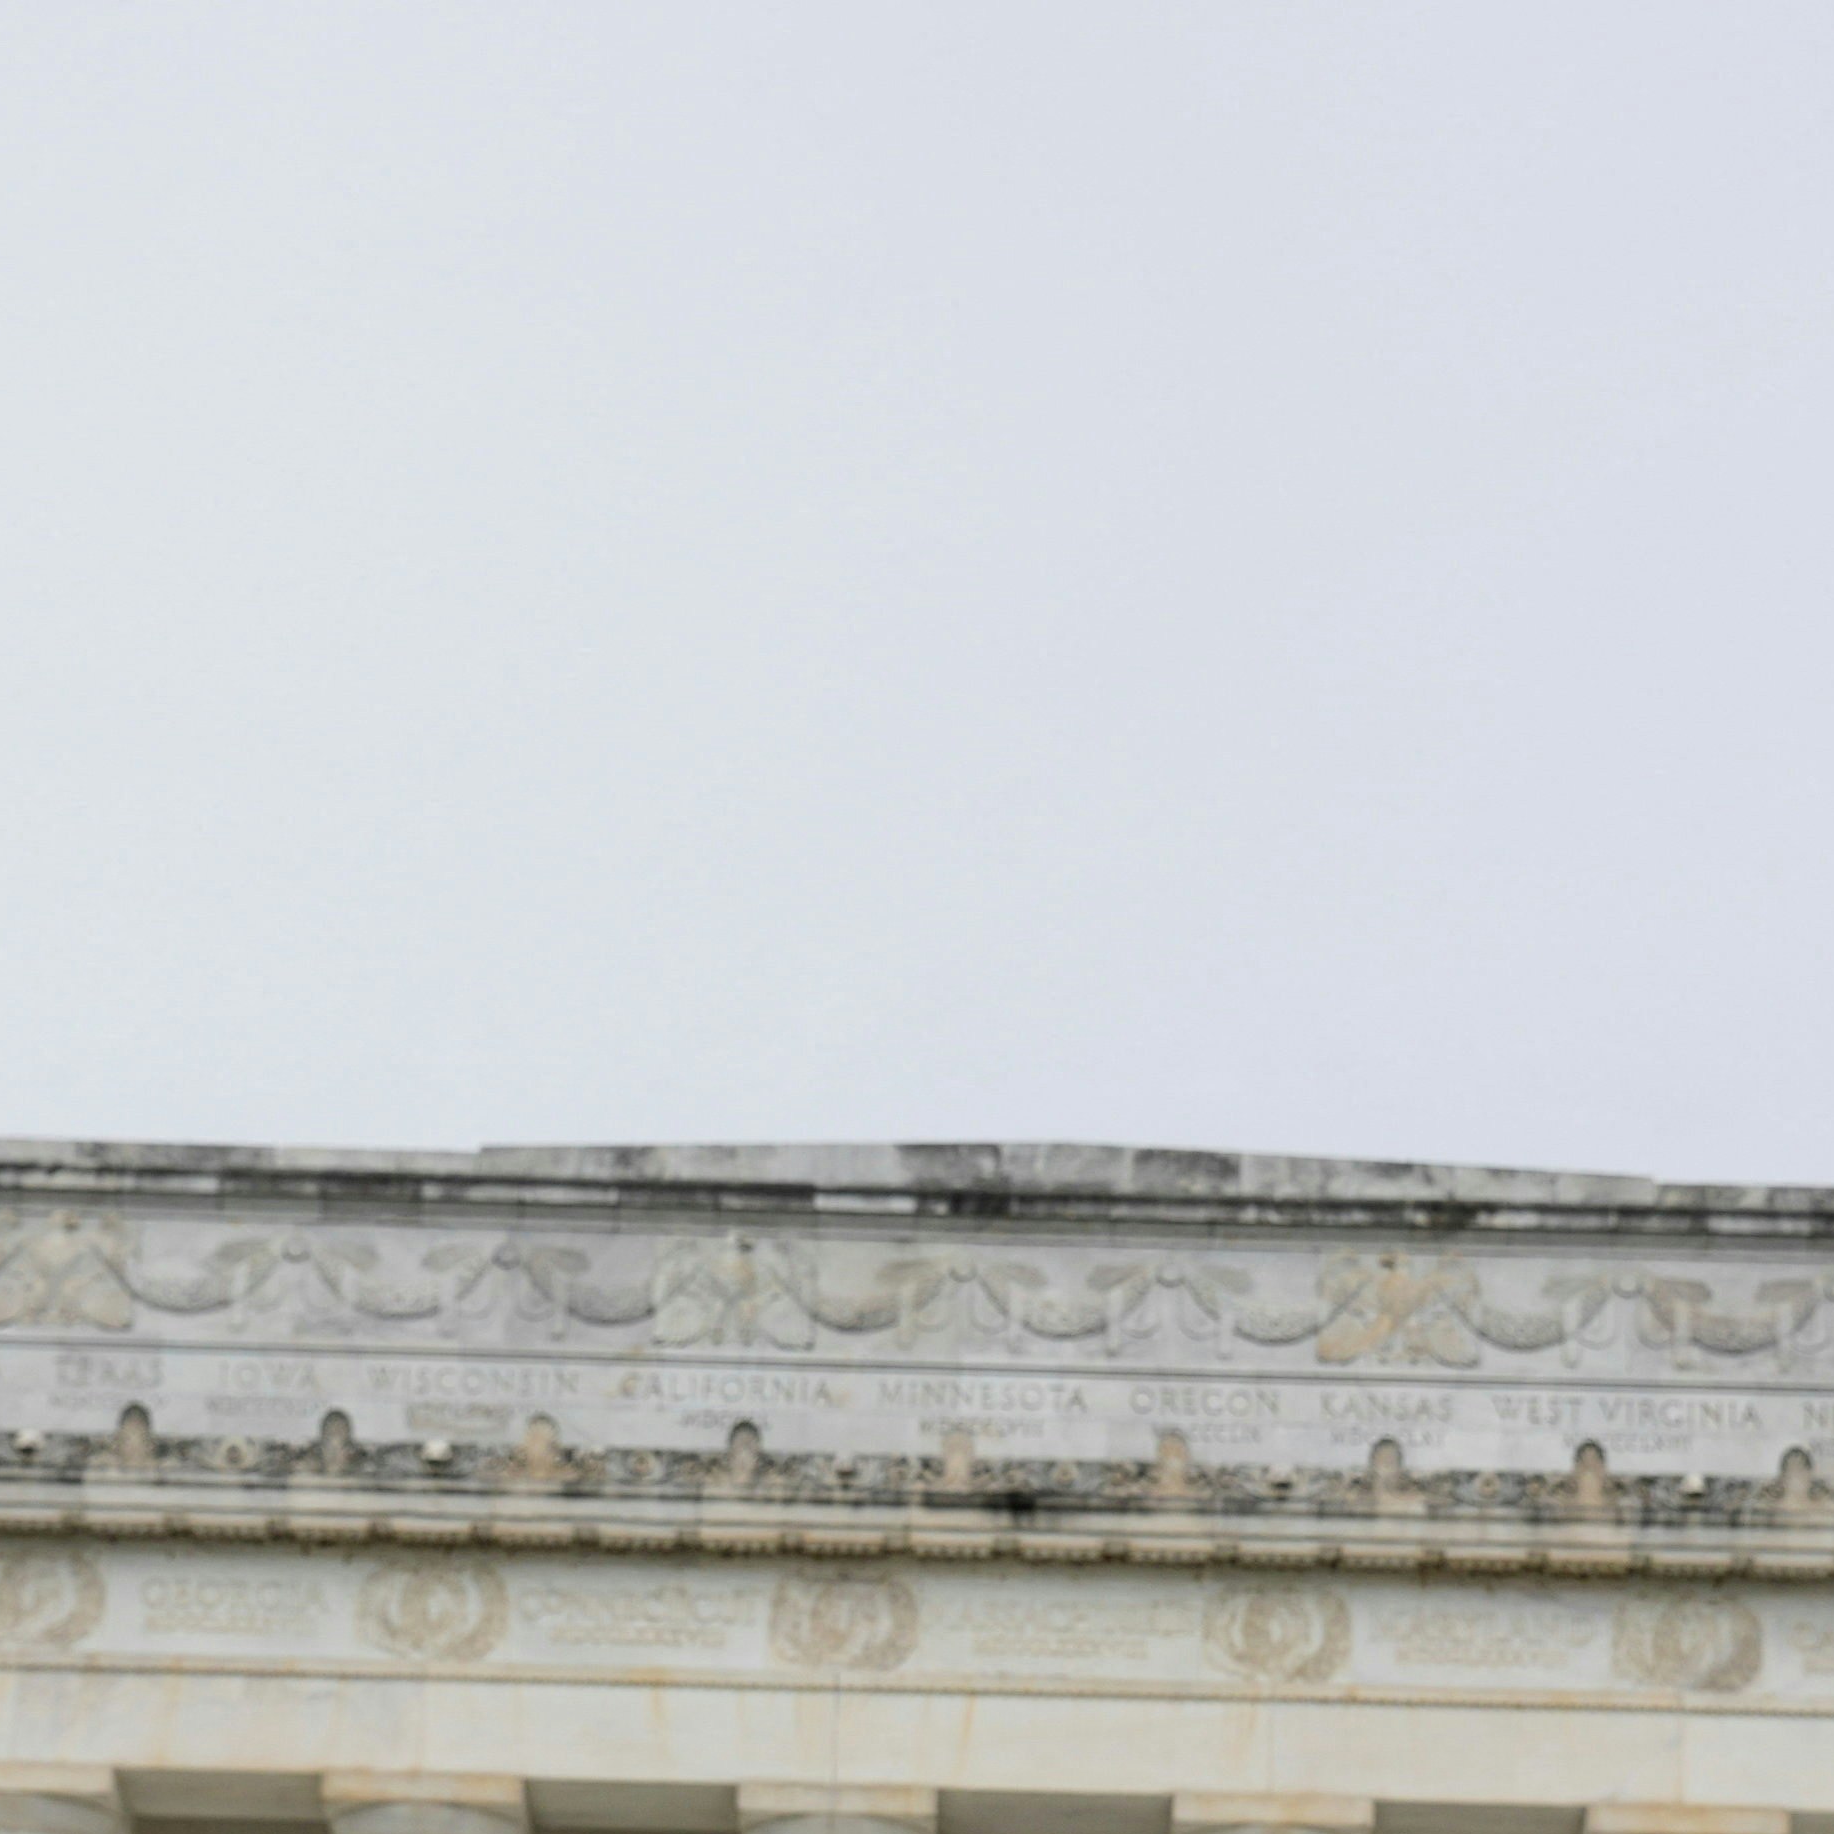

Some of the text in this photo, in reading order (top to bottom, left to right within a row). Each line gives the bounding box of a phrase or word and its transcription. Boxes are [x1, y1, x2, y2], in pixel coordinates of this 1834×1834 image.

[367, 1366, 580, 1396] WISCONSIN
[618, 1372, 834, 1406] CALIFORNIA
[878, 1378, 1088, 1414] MINNESOTA
[1129, 1386, 1280, 1417] OREGON
[1320, 1390, 1455, 1423] KANSAS
[1491, 1397, 1764, 1430] WEST VIRGINIA
